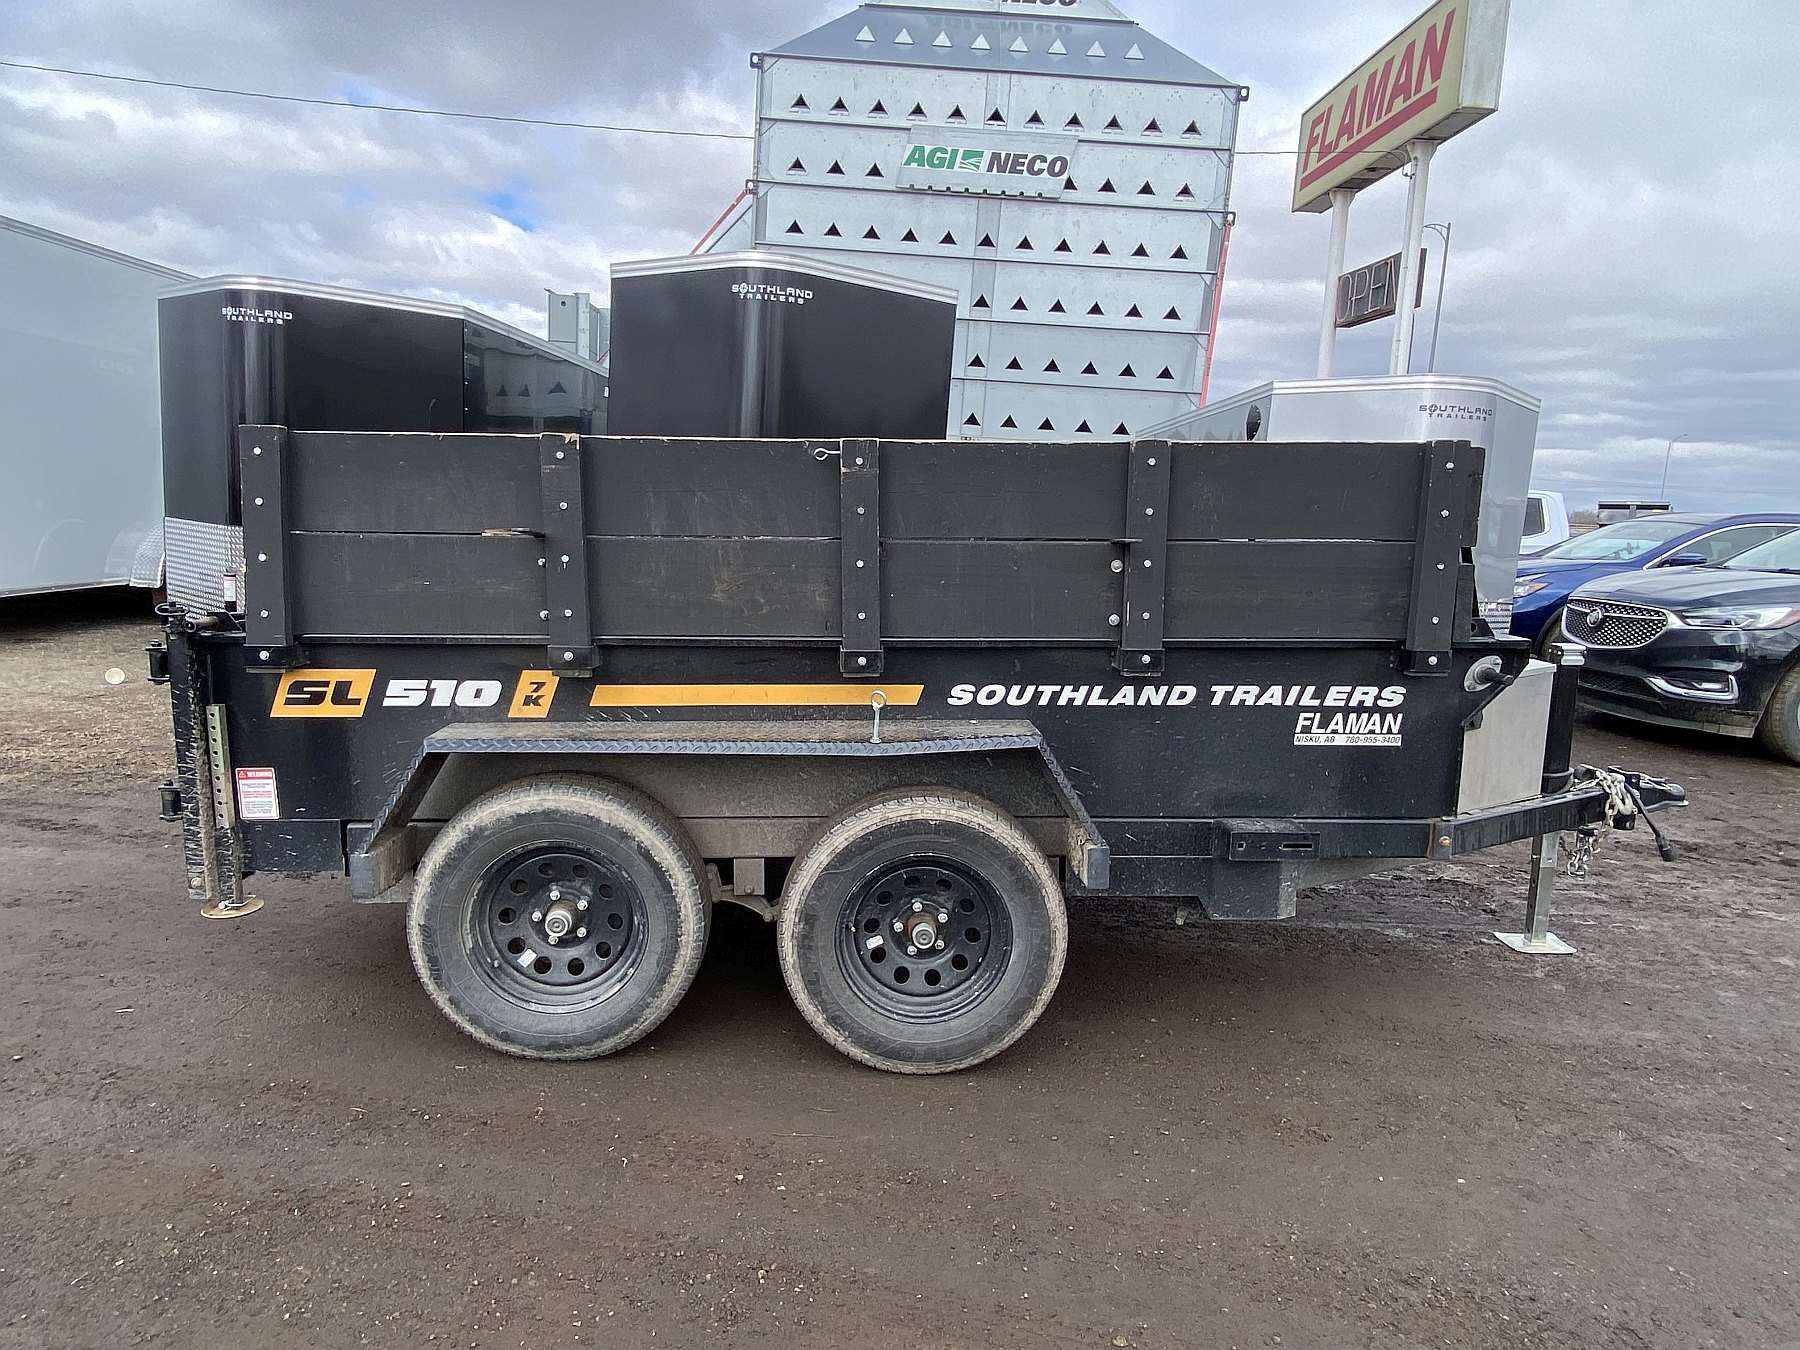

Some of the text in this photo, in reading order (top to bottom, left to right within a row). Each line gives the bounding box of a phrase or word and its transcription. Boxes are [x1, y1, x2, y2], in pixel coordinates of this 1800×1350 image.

[1302, 7, 1456, 175] FLAMAN
[903, 145, 1069, 178] AGI NECO
[731, 282, 813, 299] SOUTHLAND
[1336, 258, 1397, 322] OPEN
[739, 293, 804, 305] TRAILERS
[221, 306, 293, 320] SOUTHLAND
[226, 315, 284, 325] TRAILERS
[1418, 403, 1493, 417] SOUTHLAND
[1428, 412, 1487, 422] TRAILERS
[283, 679, 503, 707] SL 510
[529, 681, 546, 693] 7
[522, 694, 546, 707] K
[947, 684, 1407, 708] SOUTHLAND TRAILERS
[1294, 712, 1403, 734] FLAMAN
[1295, 735, 1401, 744] NISKU, AB 780-955-3400
